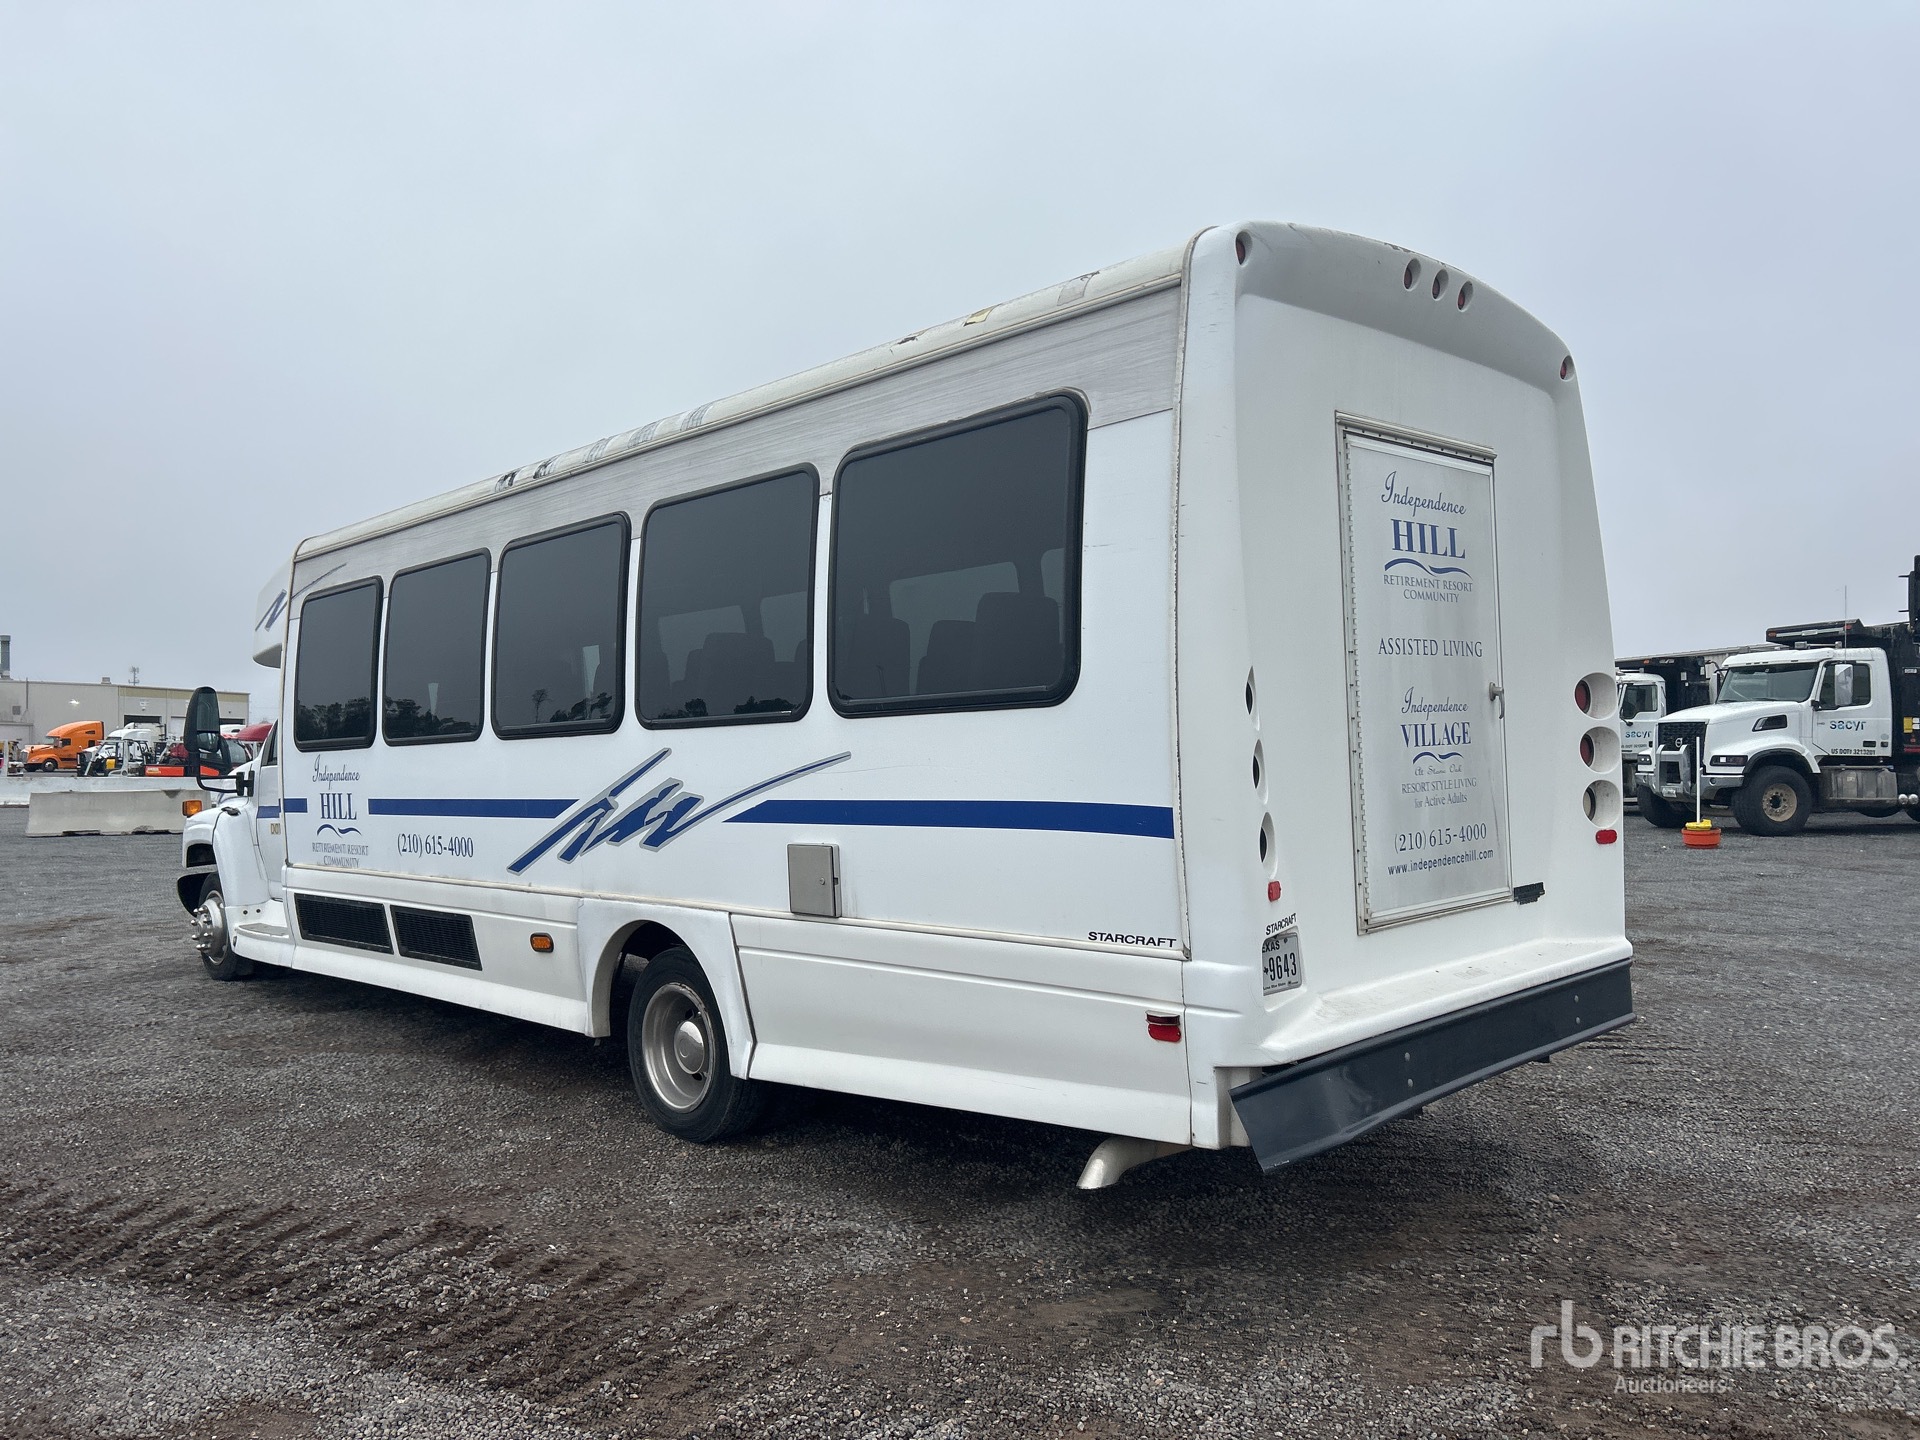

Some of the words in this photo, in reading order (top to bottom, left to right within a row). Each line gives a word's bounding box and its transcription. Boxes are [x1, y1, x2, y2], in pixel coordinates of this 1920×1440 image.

[1381, 471, 1466, 517] Independence
[1391, 518, 1465, 559] HILL
[1383, 574, 1440, 589] RETIREMENT
[1443, 580, 1473, 592] RESORT
[1403, 589, 1459, 603] COMMUNITY
[1378, 637, 1439, 656] ASSISTED
[1442, 640, 1483, 658] LIVING
[1401, 686, 1468, 720] Independence
[1400, 722, 1471, 748] VILLAGE
[1829, 720, 1866, 731] sacyr
[312, 754, 360, 790] Independence
[1401, 782, 1430, 794] RESORT
[1431, 780, 1453, 791] STYLE
[1454, 777, 1477, 789] LIVING
[319, 792, 357, 820] HILL
[1424, 794, 1446, 807] Active
[1447, 792, 1468, 805] Adults
[312, 842, 346, 854] RETIREMENT
[347, 844, 369, 856] RESORT
[397, 832, 423, 858] (210)
[424, 834, 474, 858] 615-4000
[1394, 830, 1427, 854] (210)
[1429, 822, 1487, 848] 615-4000
[323, 855, 360, 868] COMMUNITY
[1387, 849, 1493, 876] www.independencehill.com
[1265, 913, 1296, 935] STARCRAFT
[1088, 931, 1177, 948] STARCRAFT
[1262, 940, 1280, 953] EXAS
[1268, 952, 1297, 981] 9643
